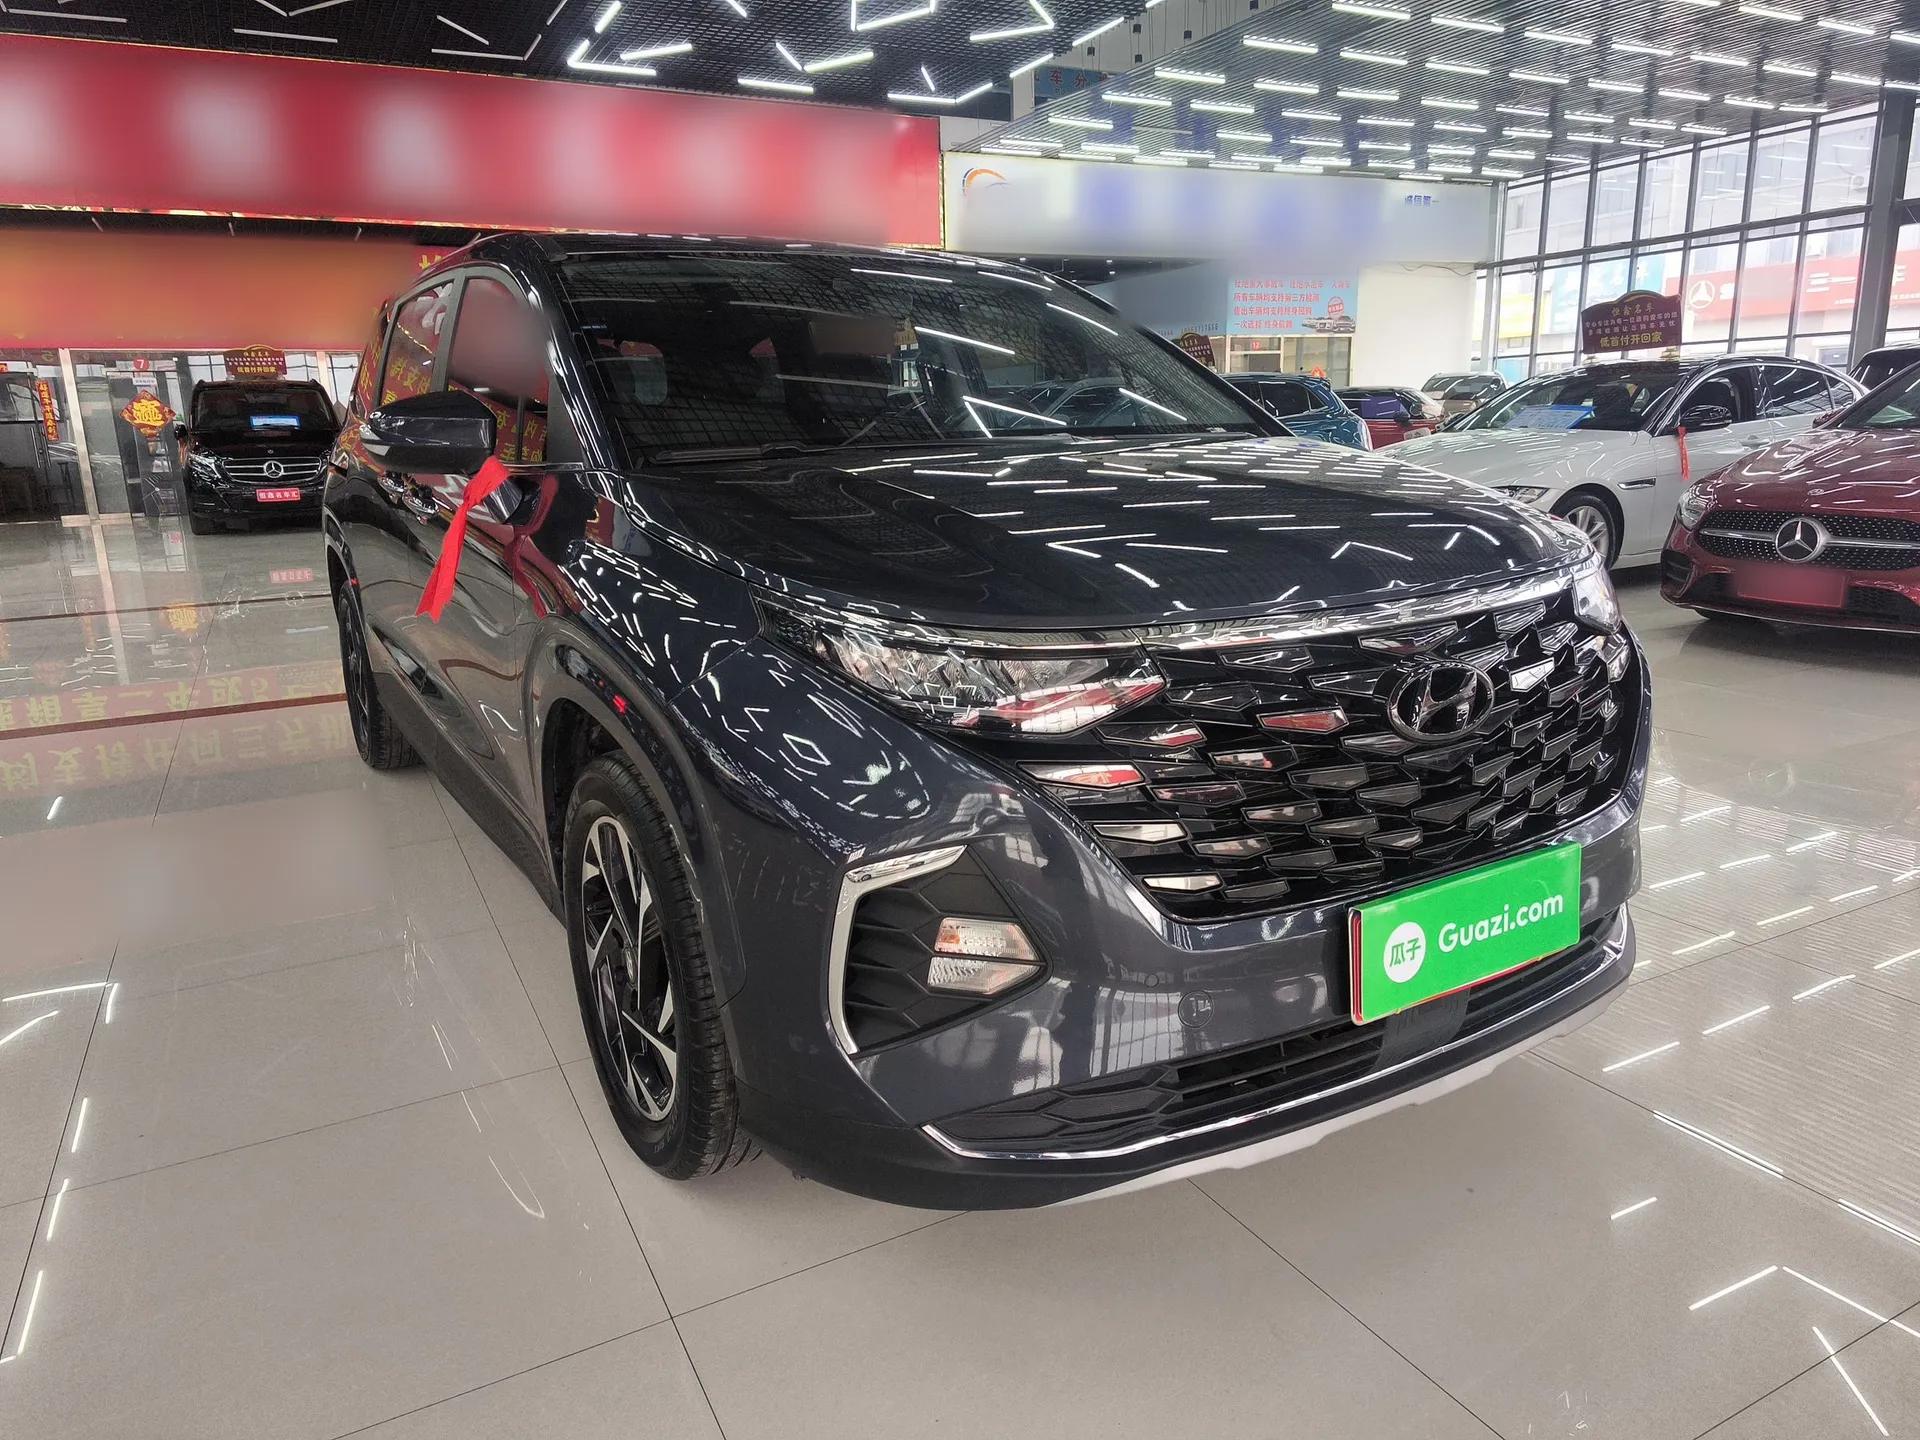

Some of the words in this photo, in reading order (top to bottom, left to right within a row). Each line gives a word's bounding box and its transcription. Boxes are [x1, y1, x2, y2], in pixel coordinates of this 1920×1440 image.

[1600, 331, 1663, 348] 低首付开回家
[136, 359, 145, 369] 7
